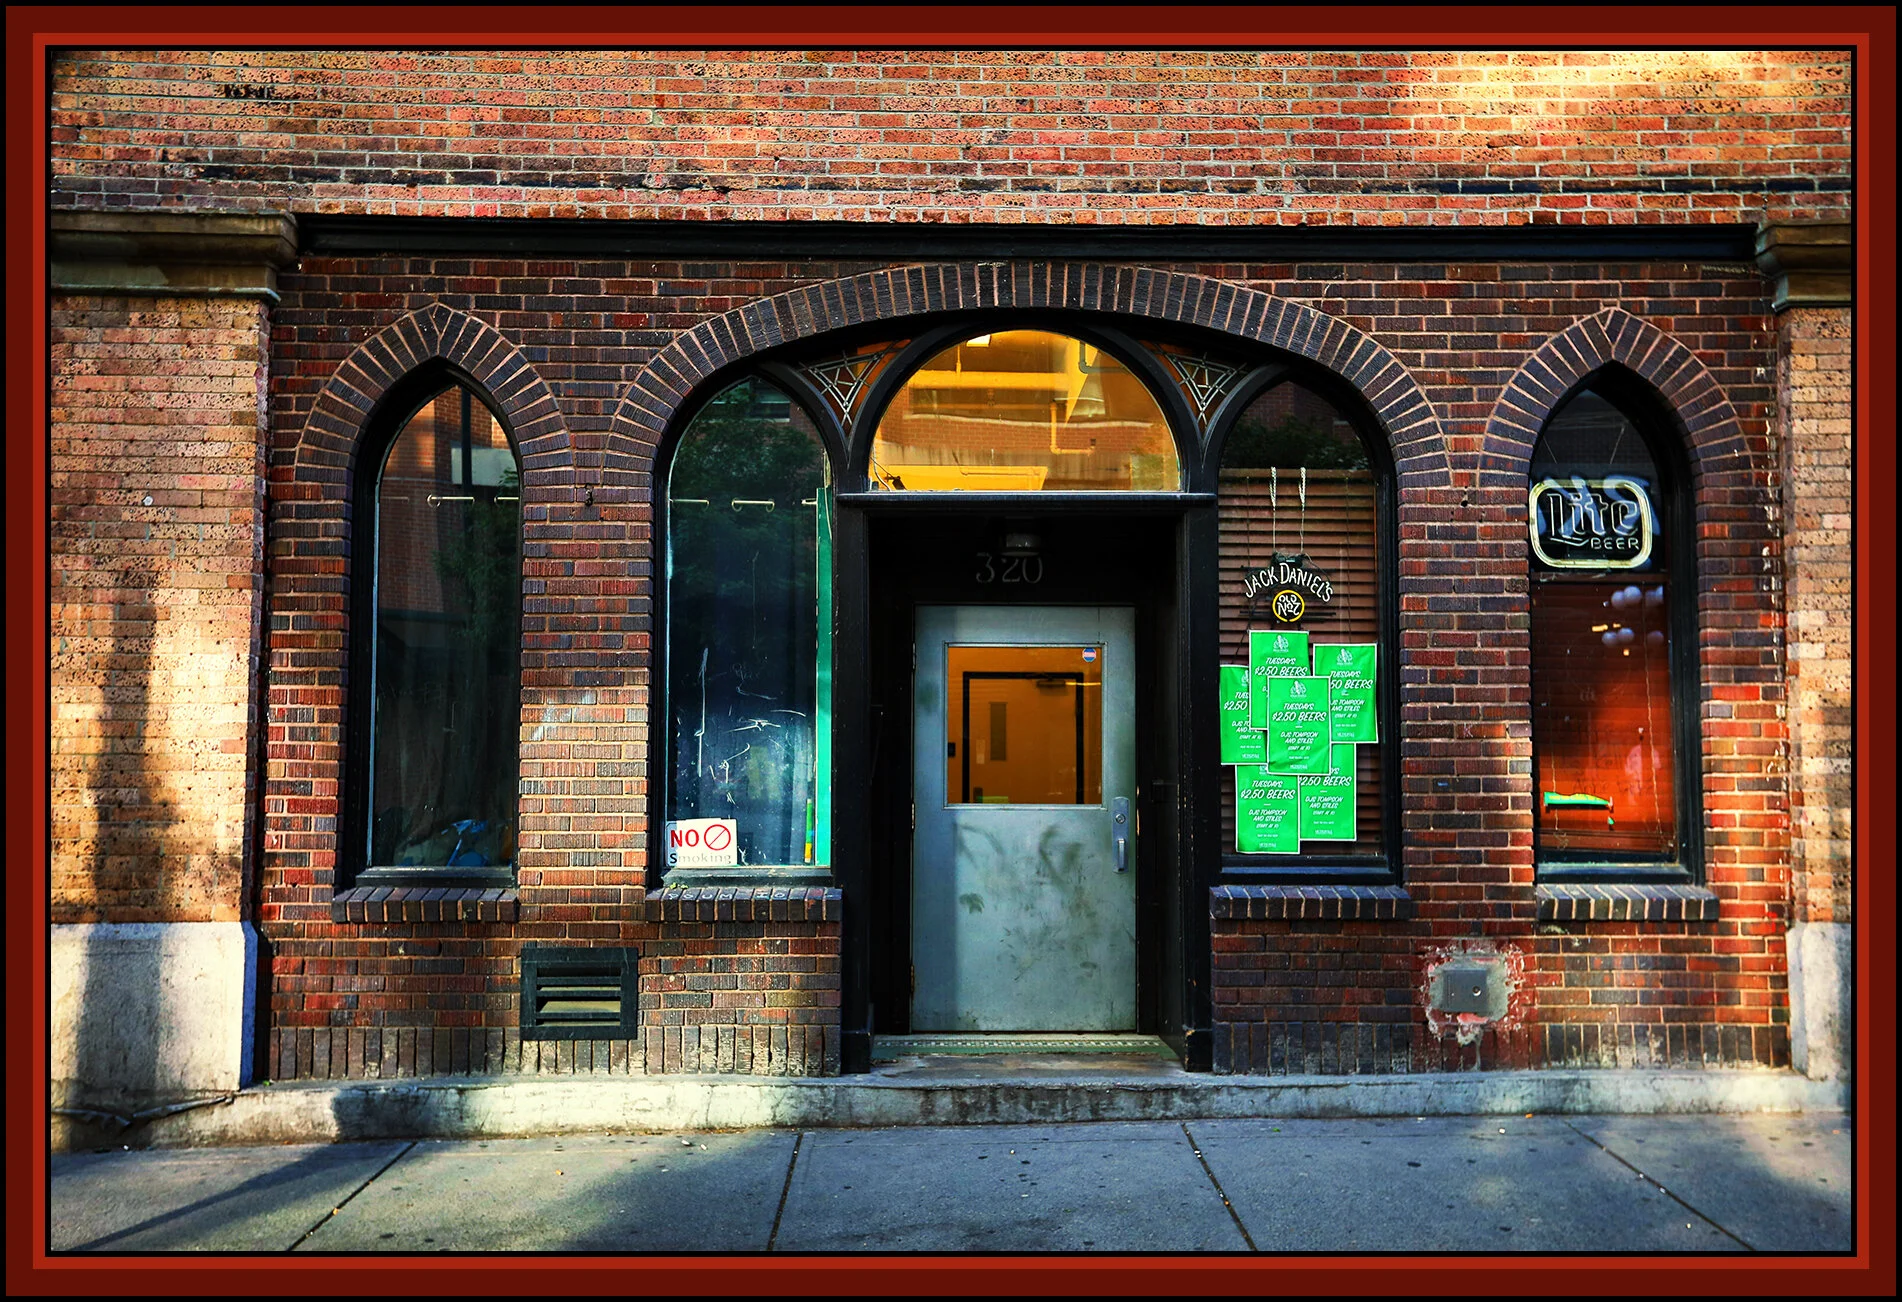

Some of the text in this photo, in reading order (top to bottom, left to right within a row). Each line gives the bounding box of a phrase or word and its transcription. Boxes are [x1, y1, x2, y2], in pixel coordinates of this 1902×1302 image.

[1547, 492, 1639, 546] Lite
[1590, 537, 1640, 550] BEER
[975, 553, 1044, 583] 320
[1244, 566, 1279, 598] JACK
[1278, 594, 1298, 603] OLD
[1254, 666, 1308, 676] $2.50 BEERS
[1331, 679, 1373, 689] 50 BEERS
[1235, 691, 1249, 699] TUES
[1224, 701, 1248, 710] $2.50
[1272, 712, 1327, 721] $2.50 BEERS
[1323, 776, 1352, 786] BEERS
[1240, 789, 1296, 799] $2.50 BEERS
[670, 829, 700, 848] NO
[669, 853, 732, 864] Smoking
